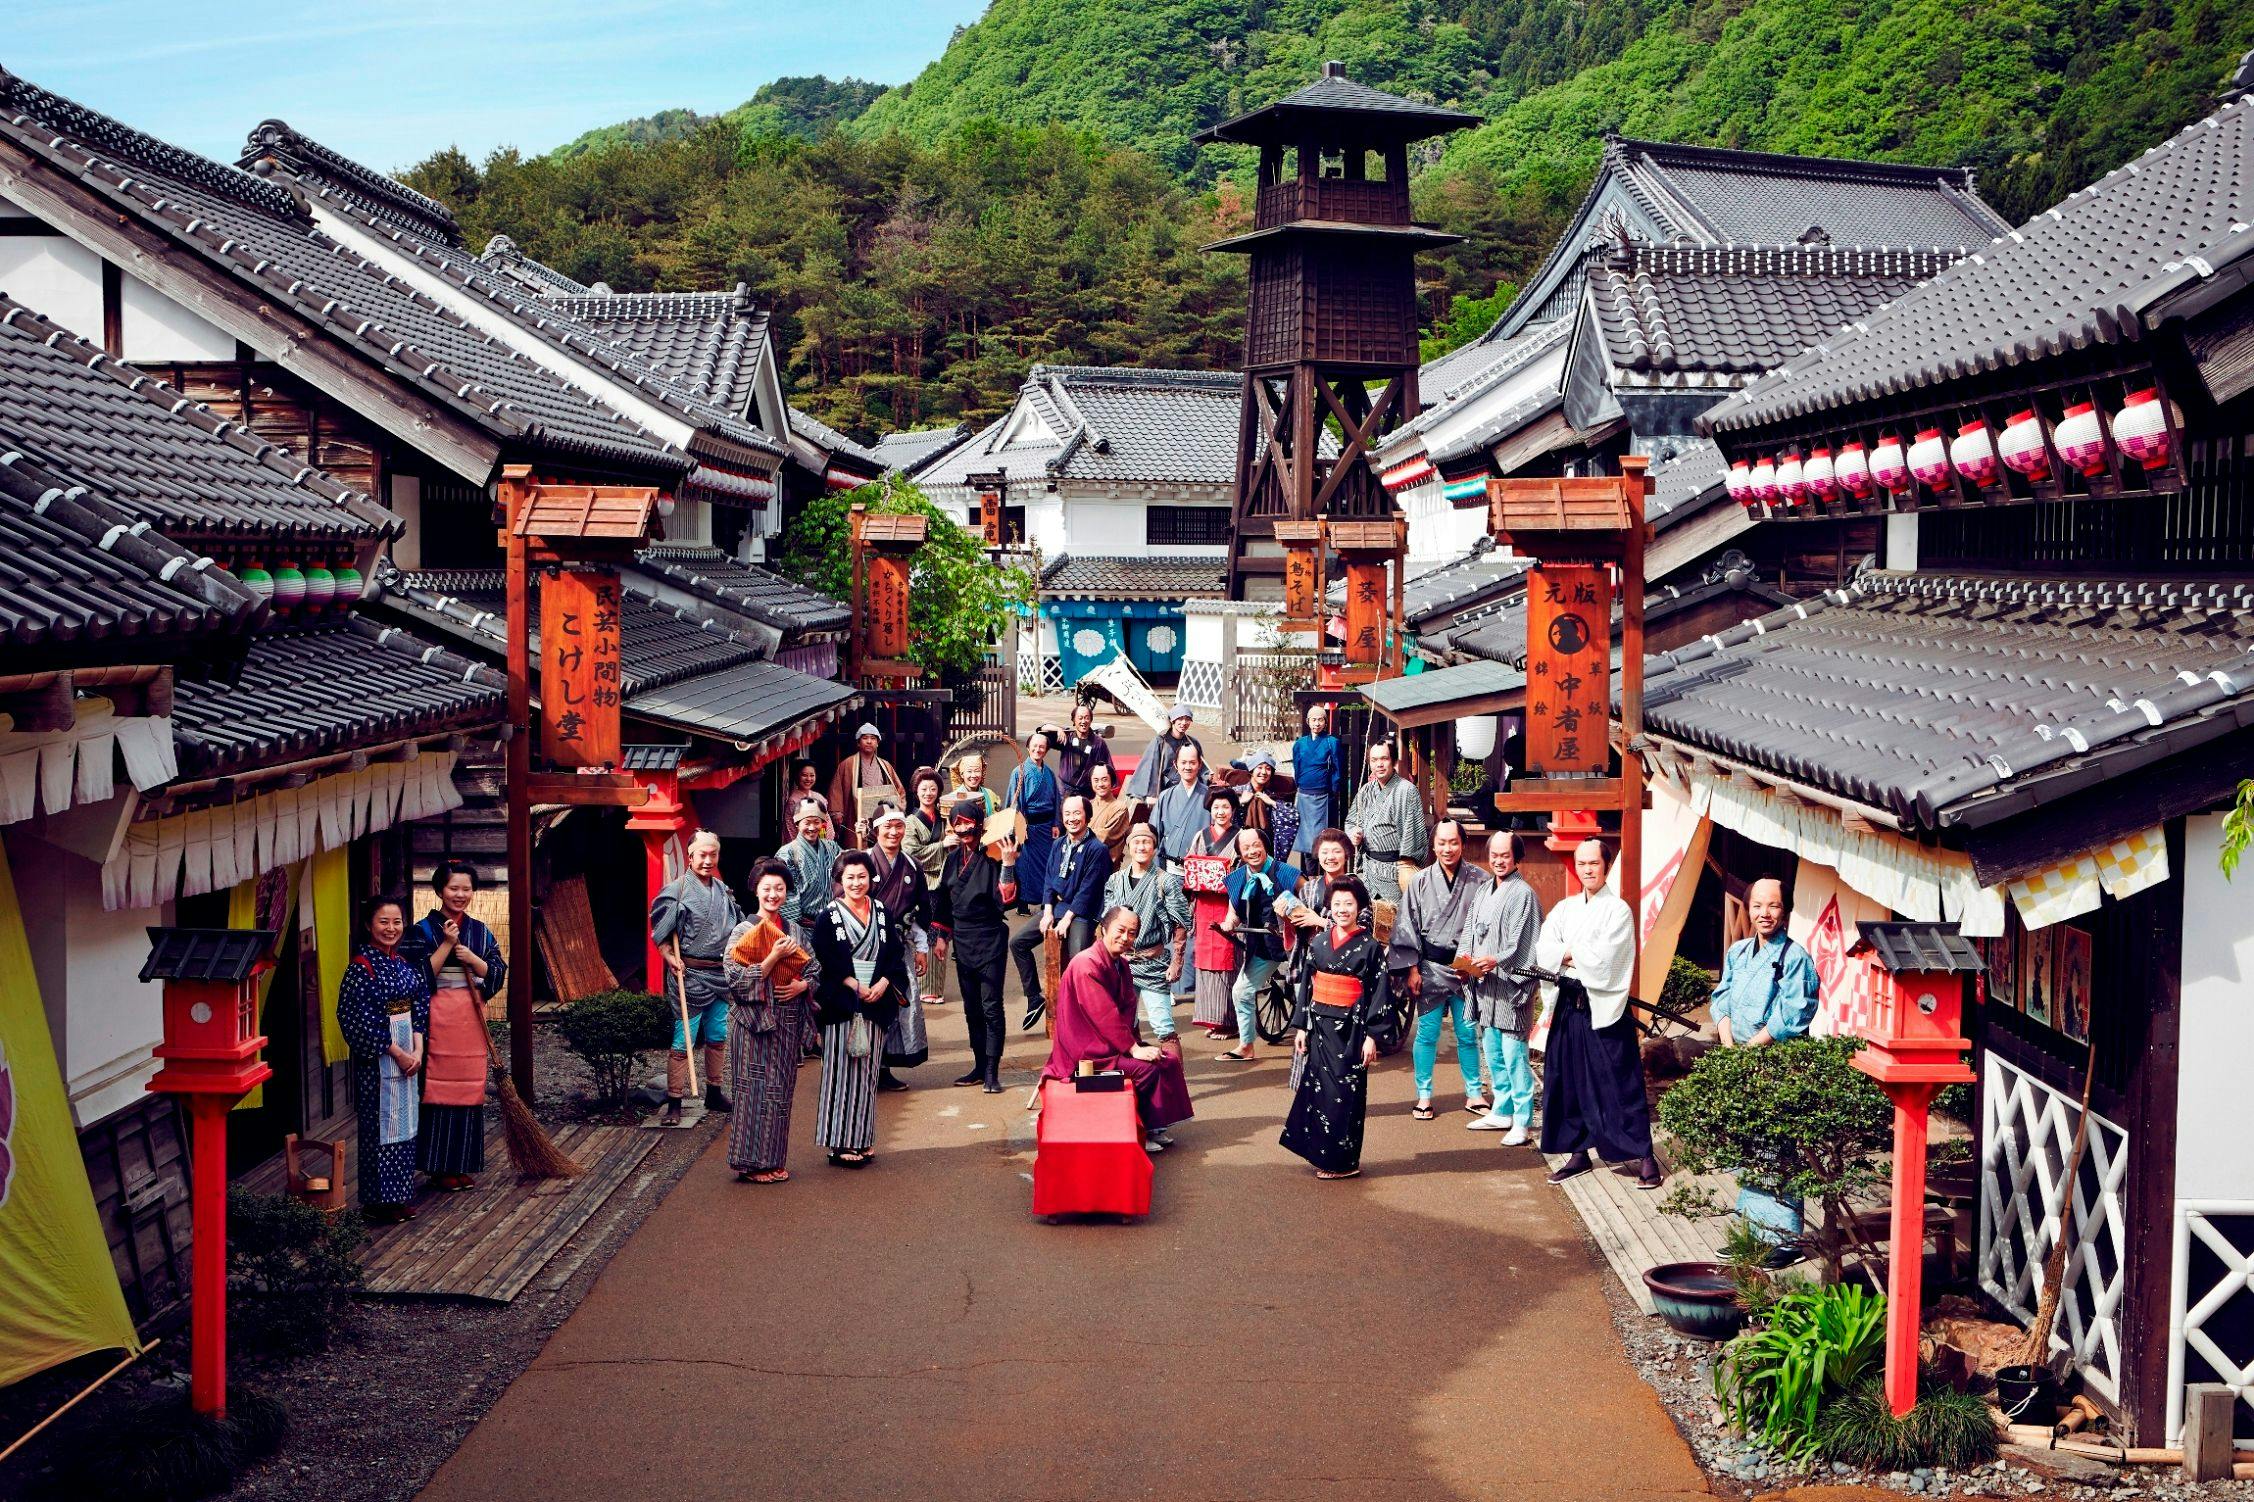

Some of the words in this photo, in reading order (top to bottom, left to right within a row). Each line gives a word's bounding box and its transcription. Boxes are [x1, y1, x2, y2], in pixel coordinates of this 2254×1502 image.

[556, 612, 586, 742] こけし堂
[593, 585, 618, 709] 民芸小間物
